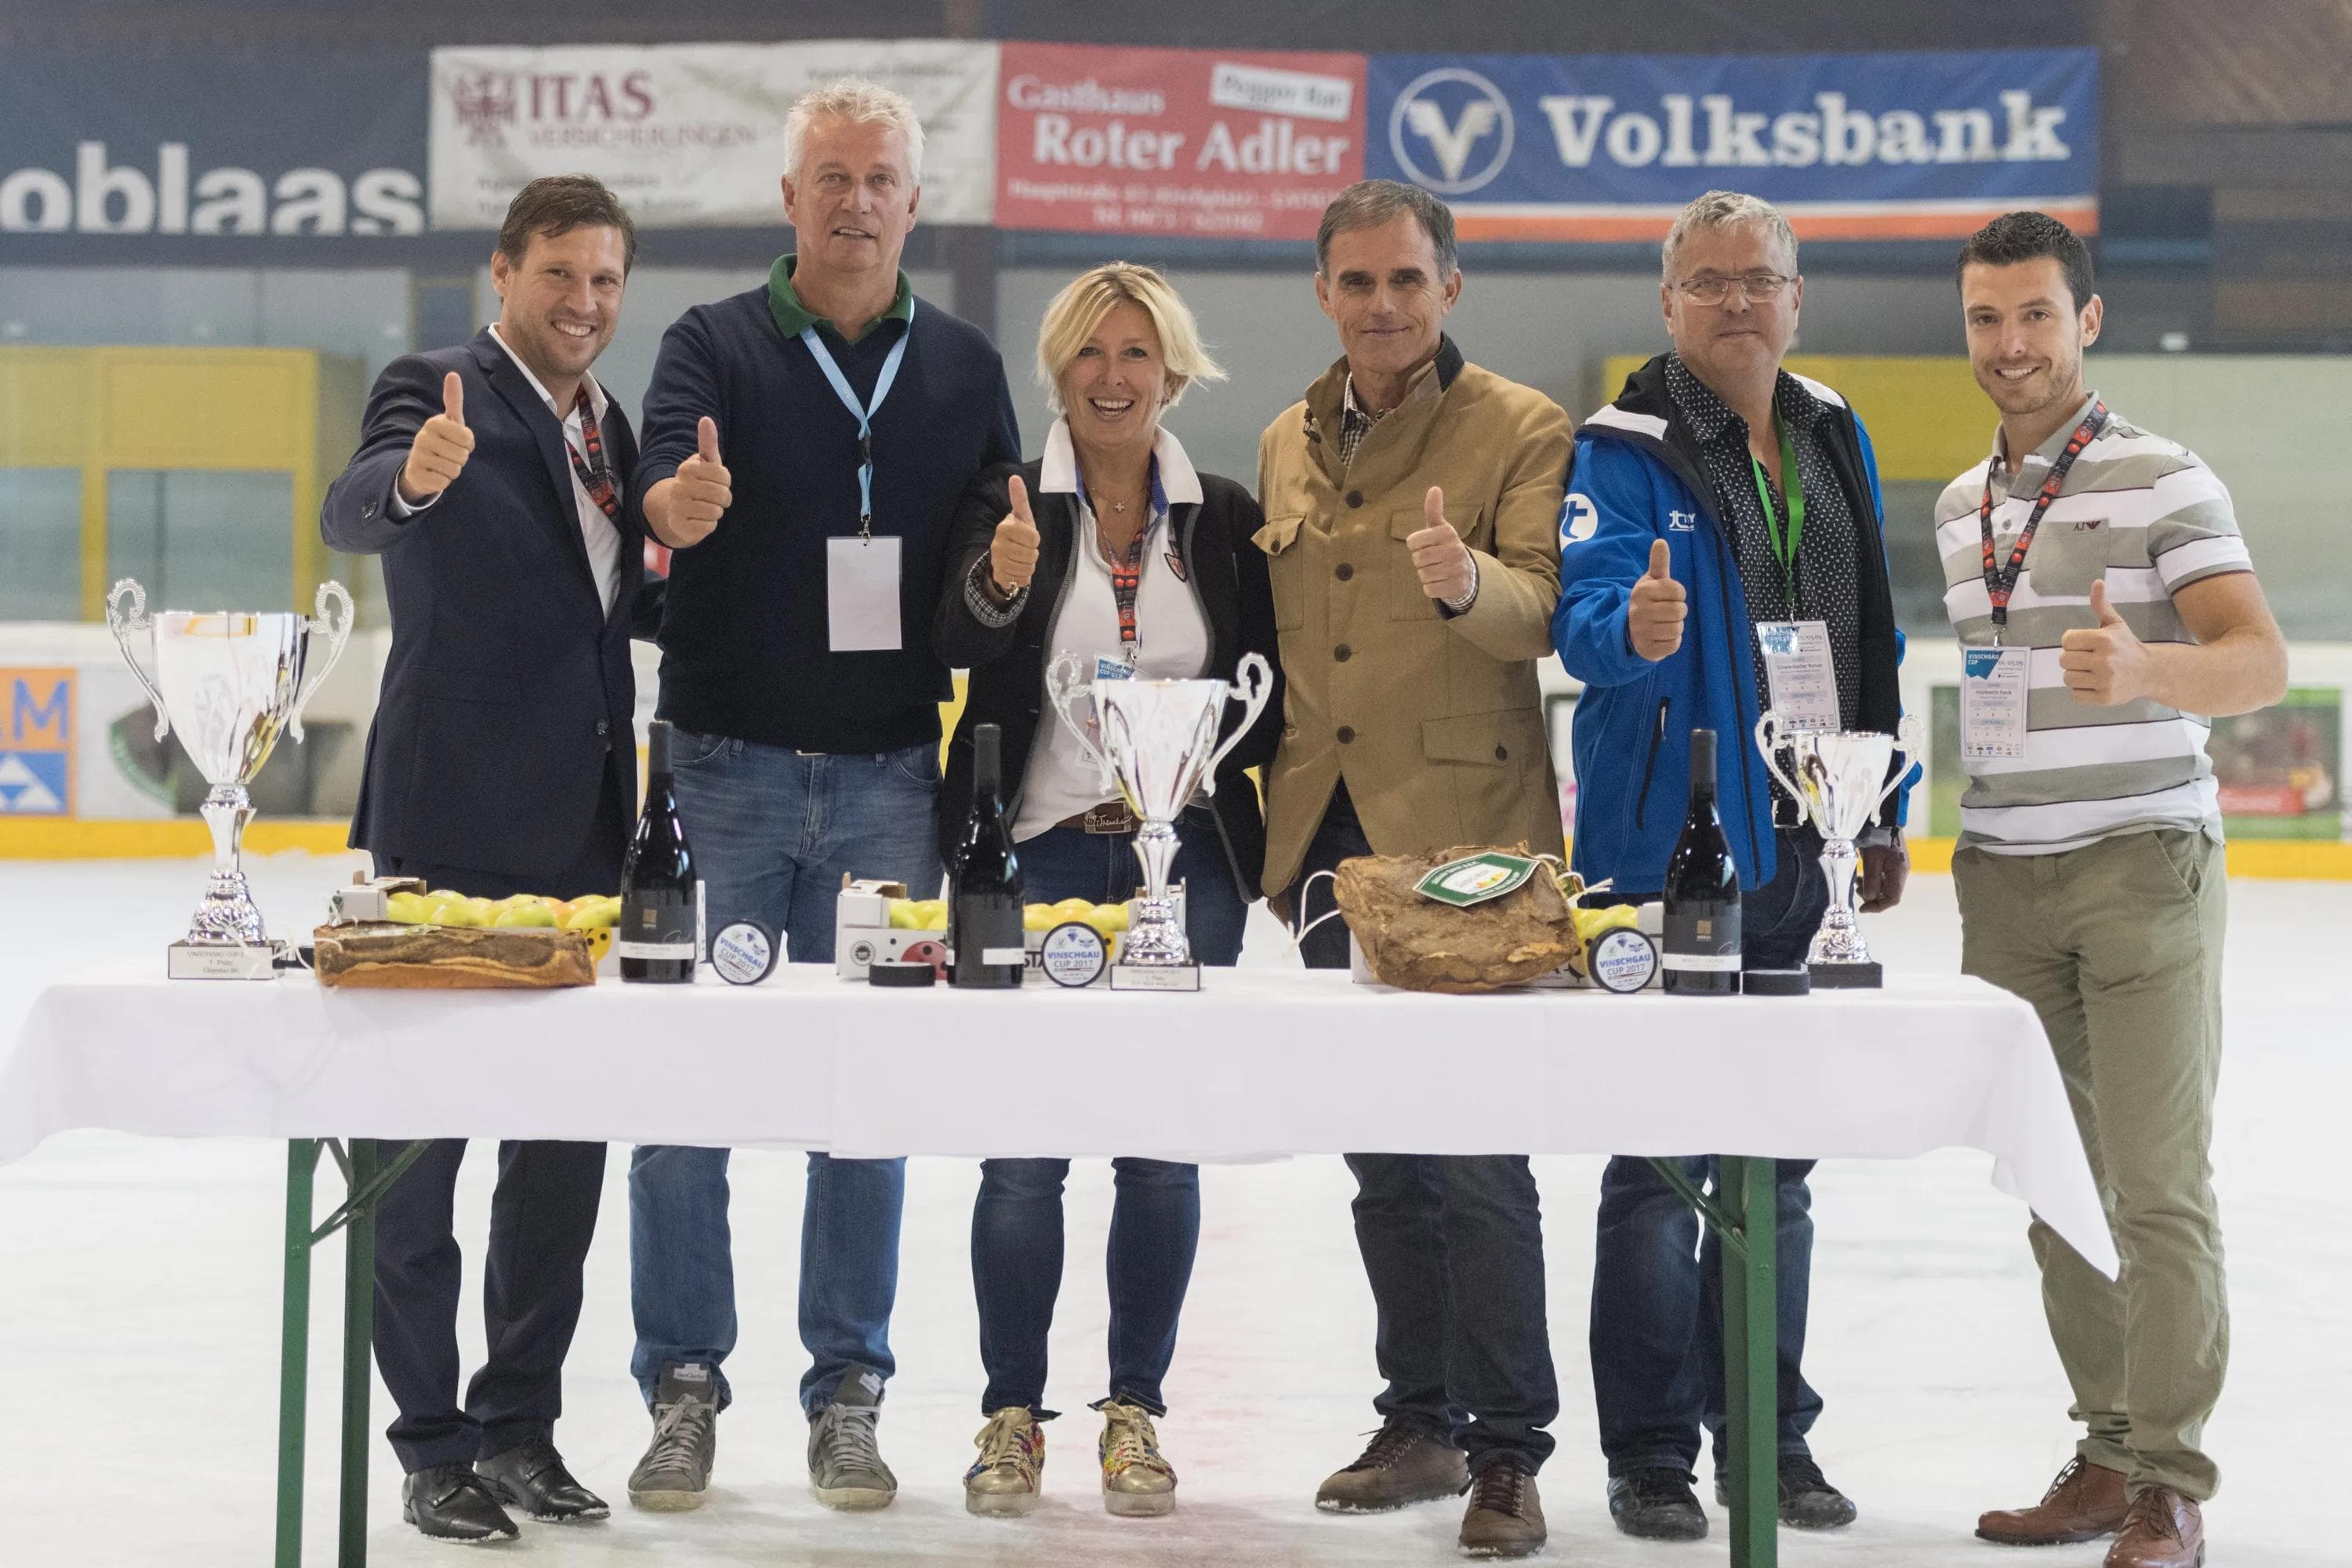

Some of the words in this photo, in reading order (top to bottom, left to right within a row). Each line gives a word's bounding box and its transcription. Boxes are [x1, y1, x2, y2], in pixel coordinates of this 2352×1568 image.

[529, 71, 655, 120] ITAS
[1540, 89, 2071, 168] Volksbank
[1034, 114, 1184, 171] Roter
[1197, 119, 1351, 176] Adler
[2, 142, 424, 236] oblaas
[720, 937, 765, 970] VINSCHGAU
[720, 948, 737, 960] CUP
[736, 957, 754, 973] 2017
[1047, 951, 1100, 960] VINSCHGAU
[1074, 960, 1094, 968] 2017
[1599, 953, 1651, 968] VINSCHGAU
[1607, 967, 1624, 976] CUP
[1626, 964, 1646, 973] 2017
